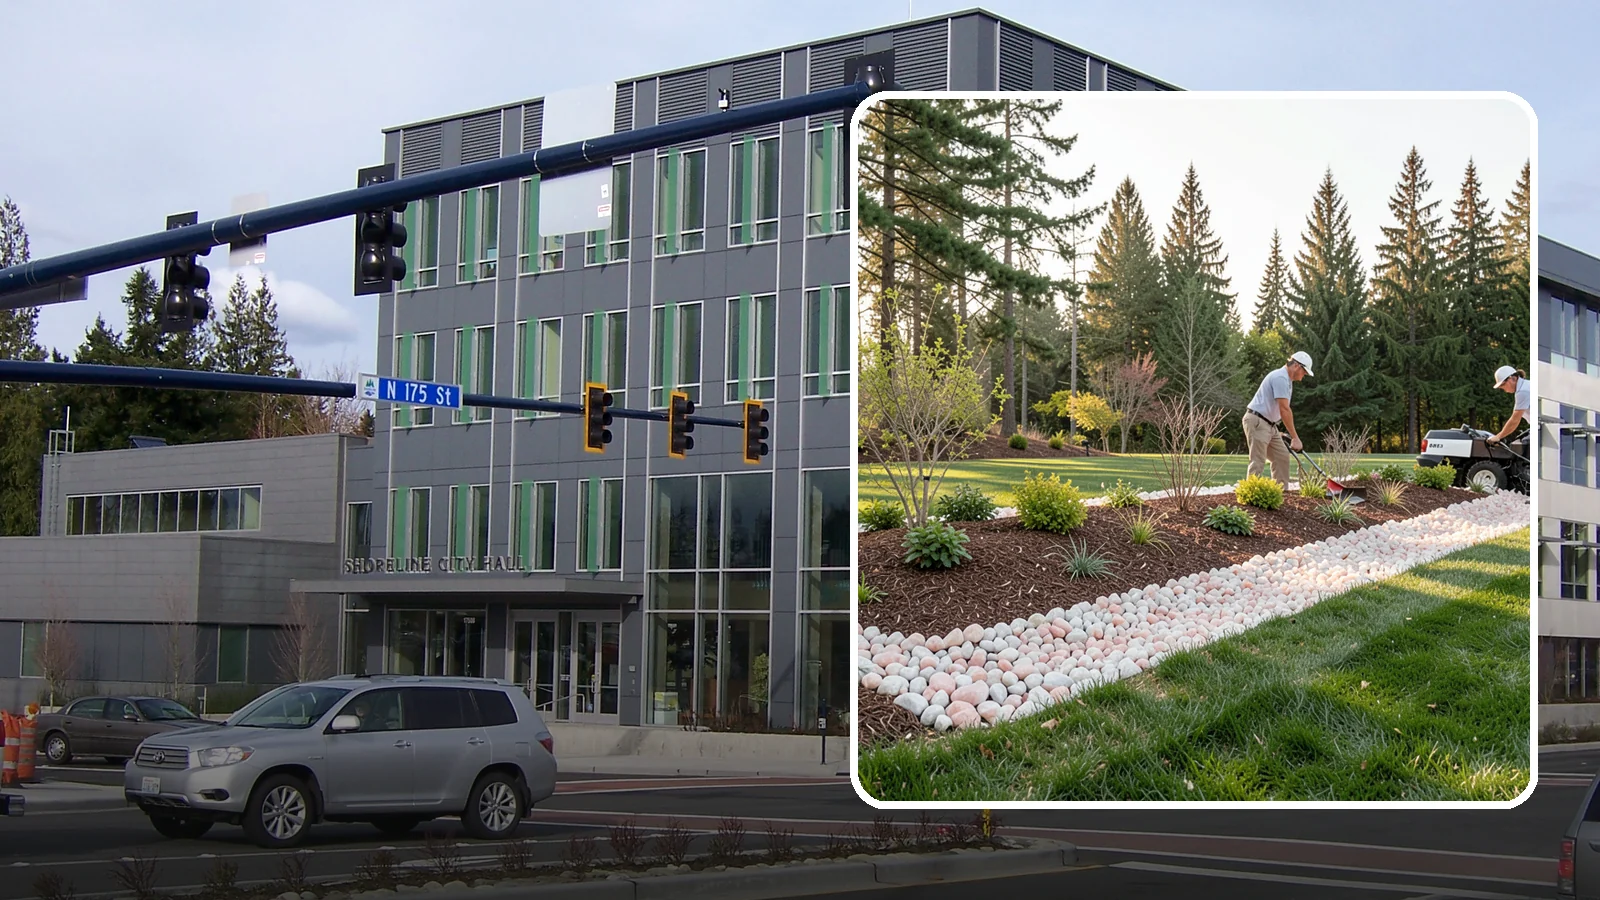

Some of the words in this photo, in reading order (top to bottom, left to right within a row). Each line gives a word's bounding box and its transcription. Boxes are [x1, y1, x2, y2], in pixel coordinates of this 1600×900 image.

[387, 380, 396, 400] N
[405, 382, 427, 403] 175
[436, 386, 451, 406] St
[344, 557, 432, 574] SHORELINE
[438, 557, 475, 572] CITY
[484, 555, 525, 572] HALL
